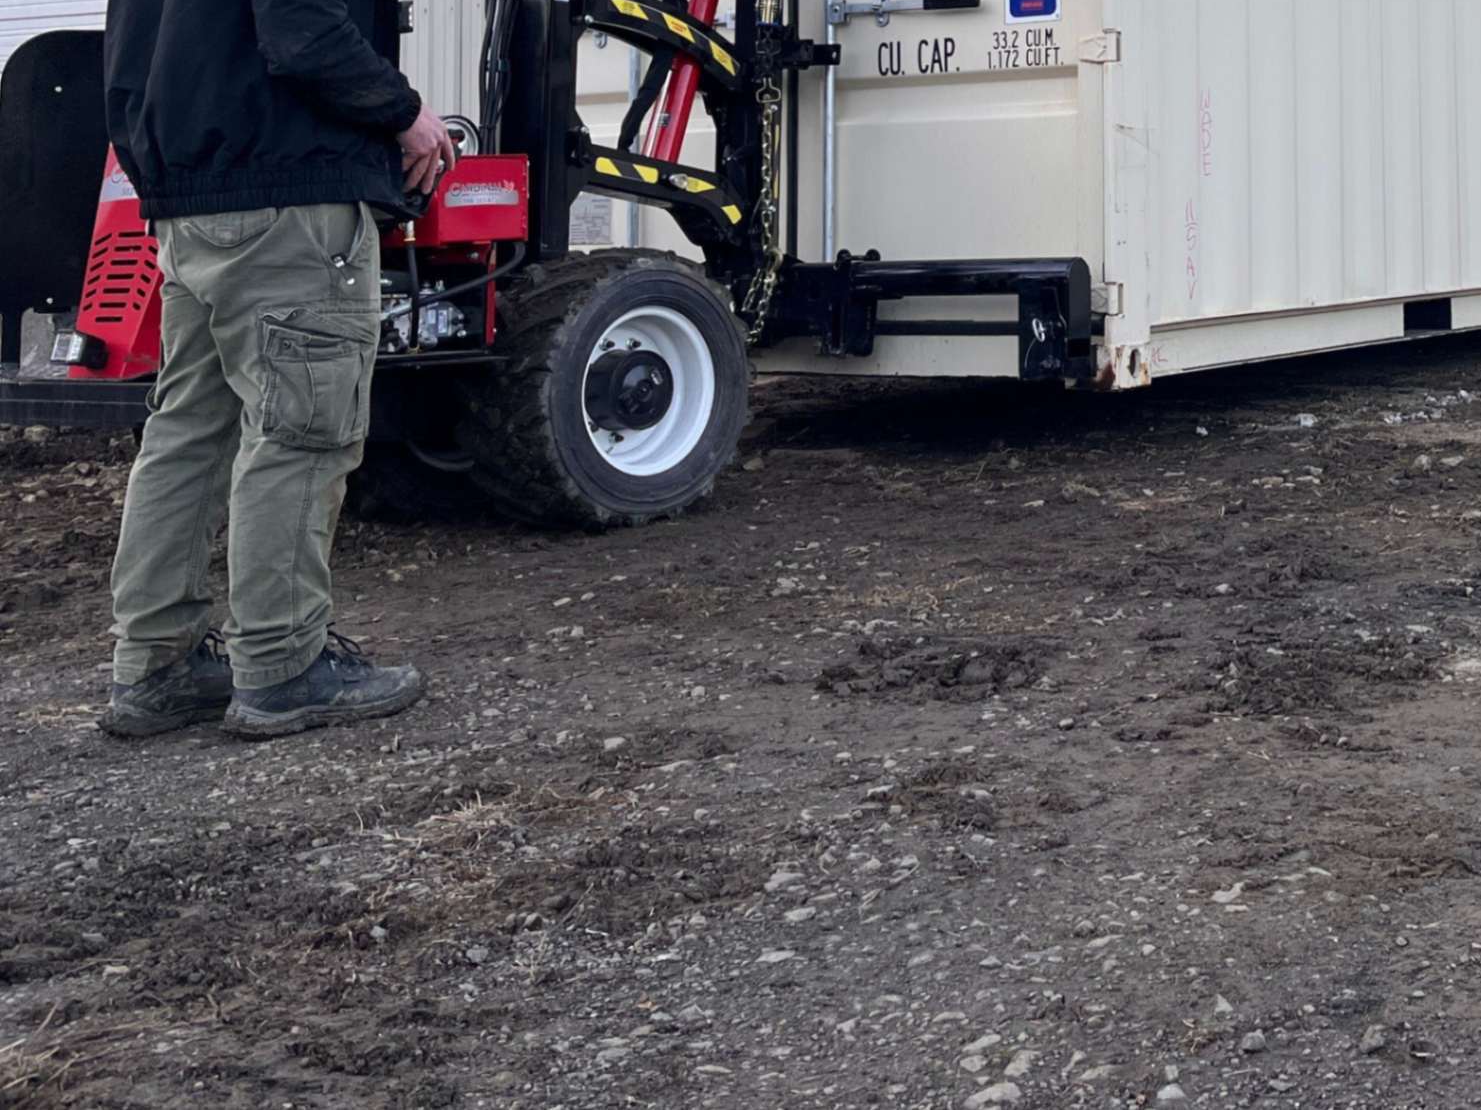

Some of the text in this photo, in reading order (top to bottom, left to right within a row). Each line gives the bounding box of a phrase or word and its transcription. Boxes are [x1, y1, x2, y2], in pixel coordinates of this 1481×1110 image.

[992, 30, 1019, 50] 33.2
[877, 37, 960, 76] CU. CAP.
